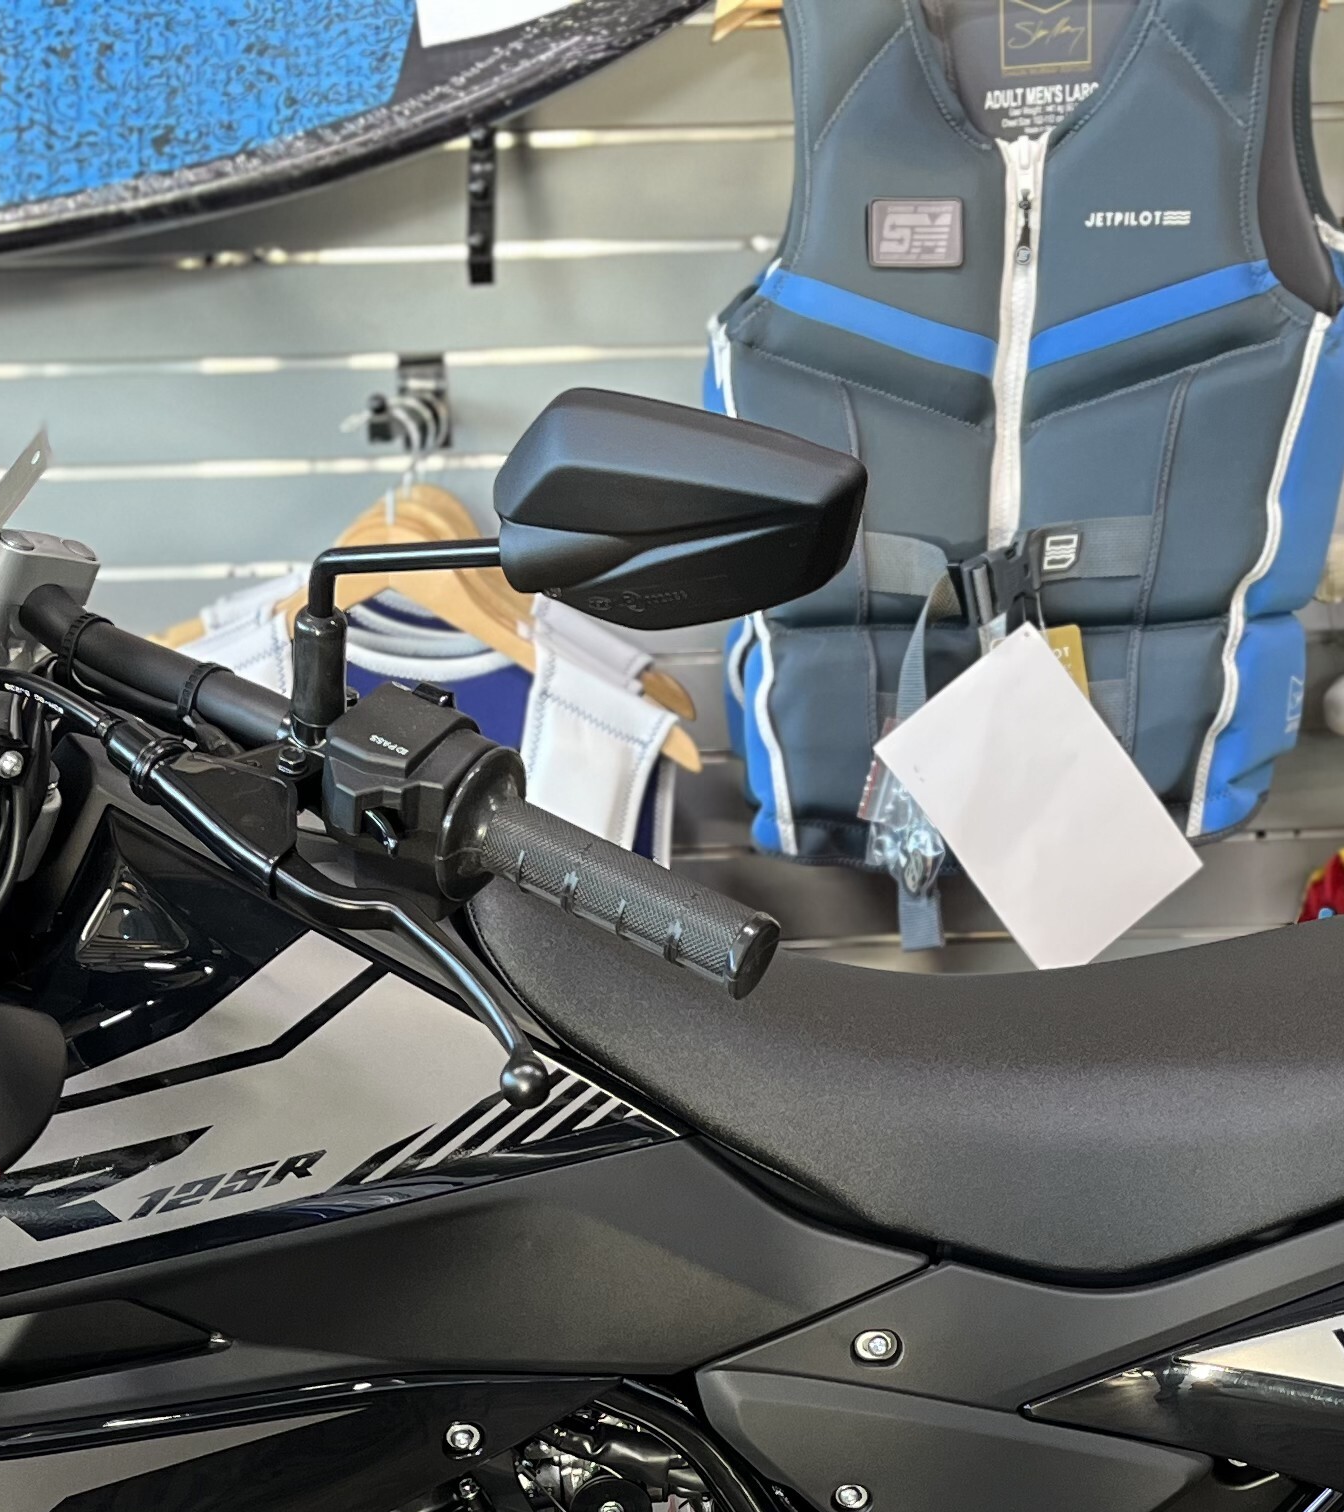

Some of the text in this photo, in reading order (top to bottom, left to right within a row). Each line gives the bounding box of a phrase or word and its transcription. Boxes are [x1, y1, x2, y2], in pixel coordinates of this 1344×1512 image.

[984, 88, 1024, 110] ADULT
[1025, 84, 1063, 106] MEN'S
[1084, 210, 1162, 228] JETPILOT
[127, 1150, 327, 1221] 125R
